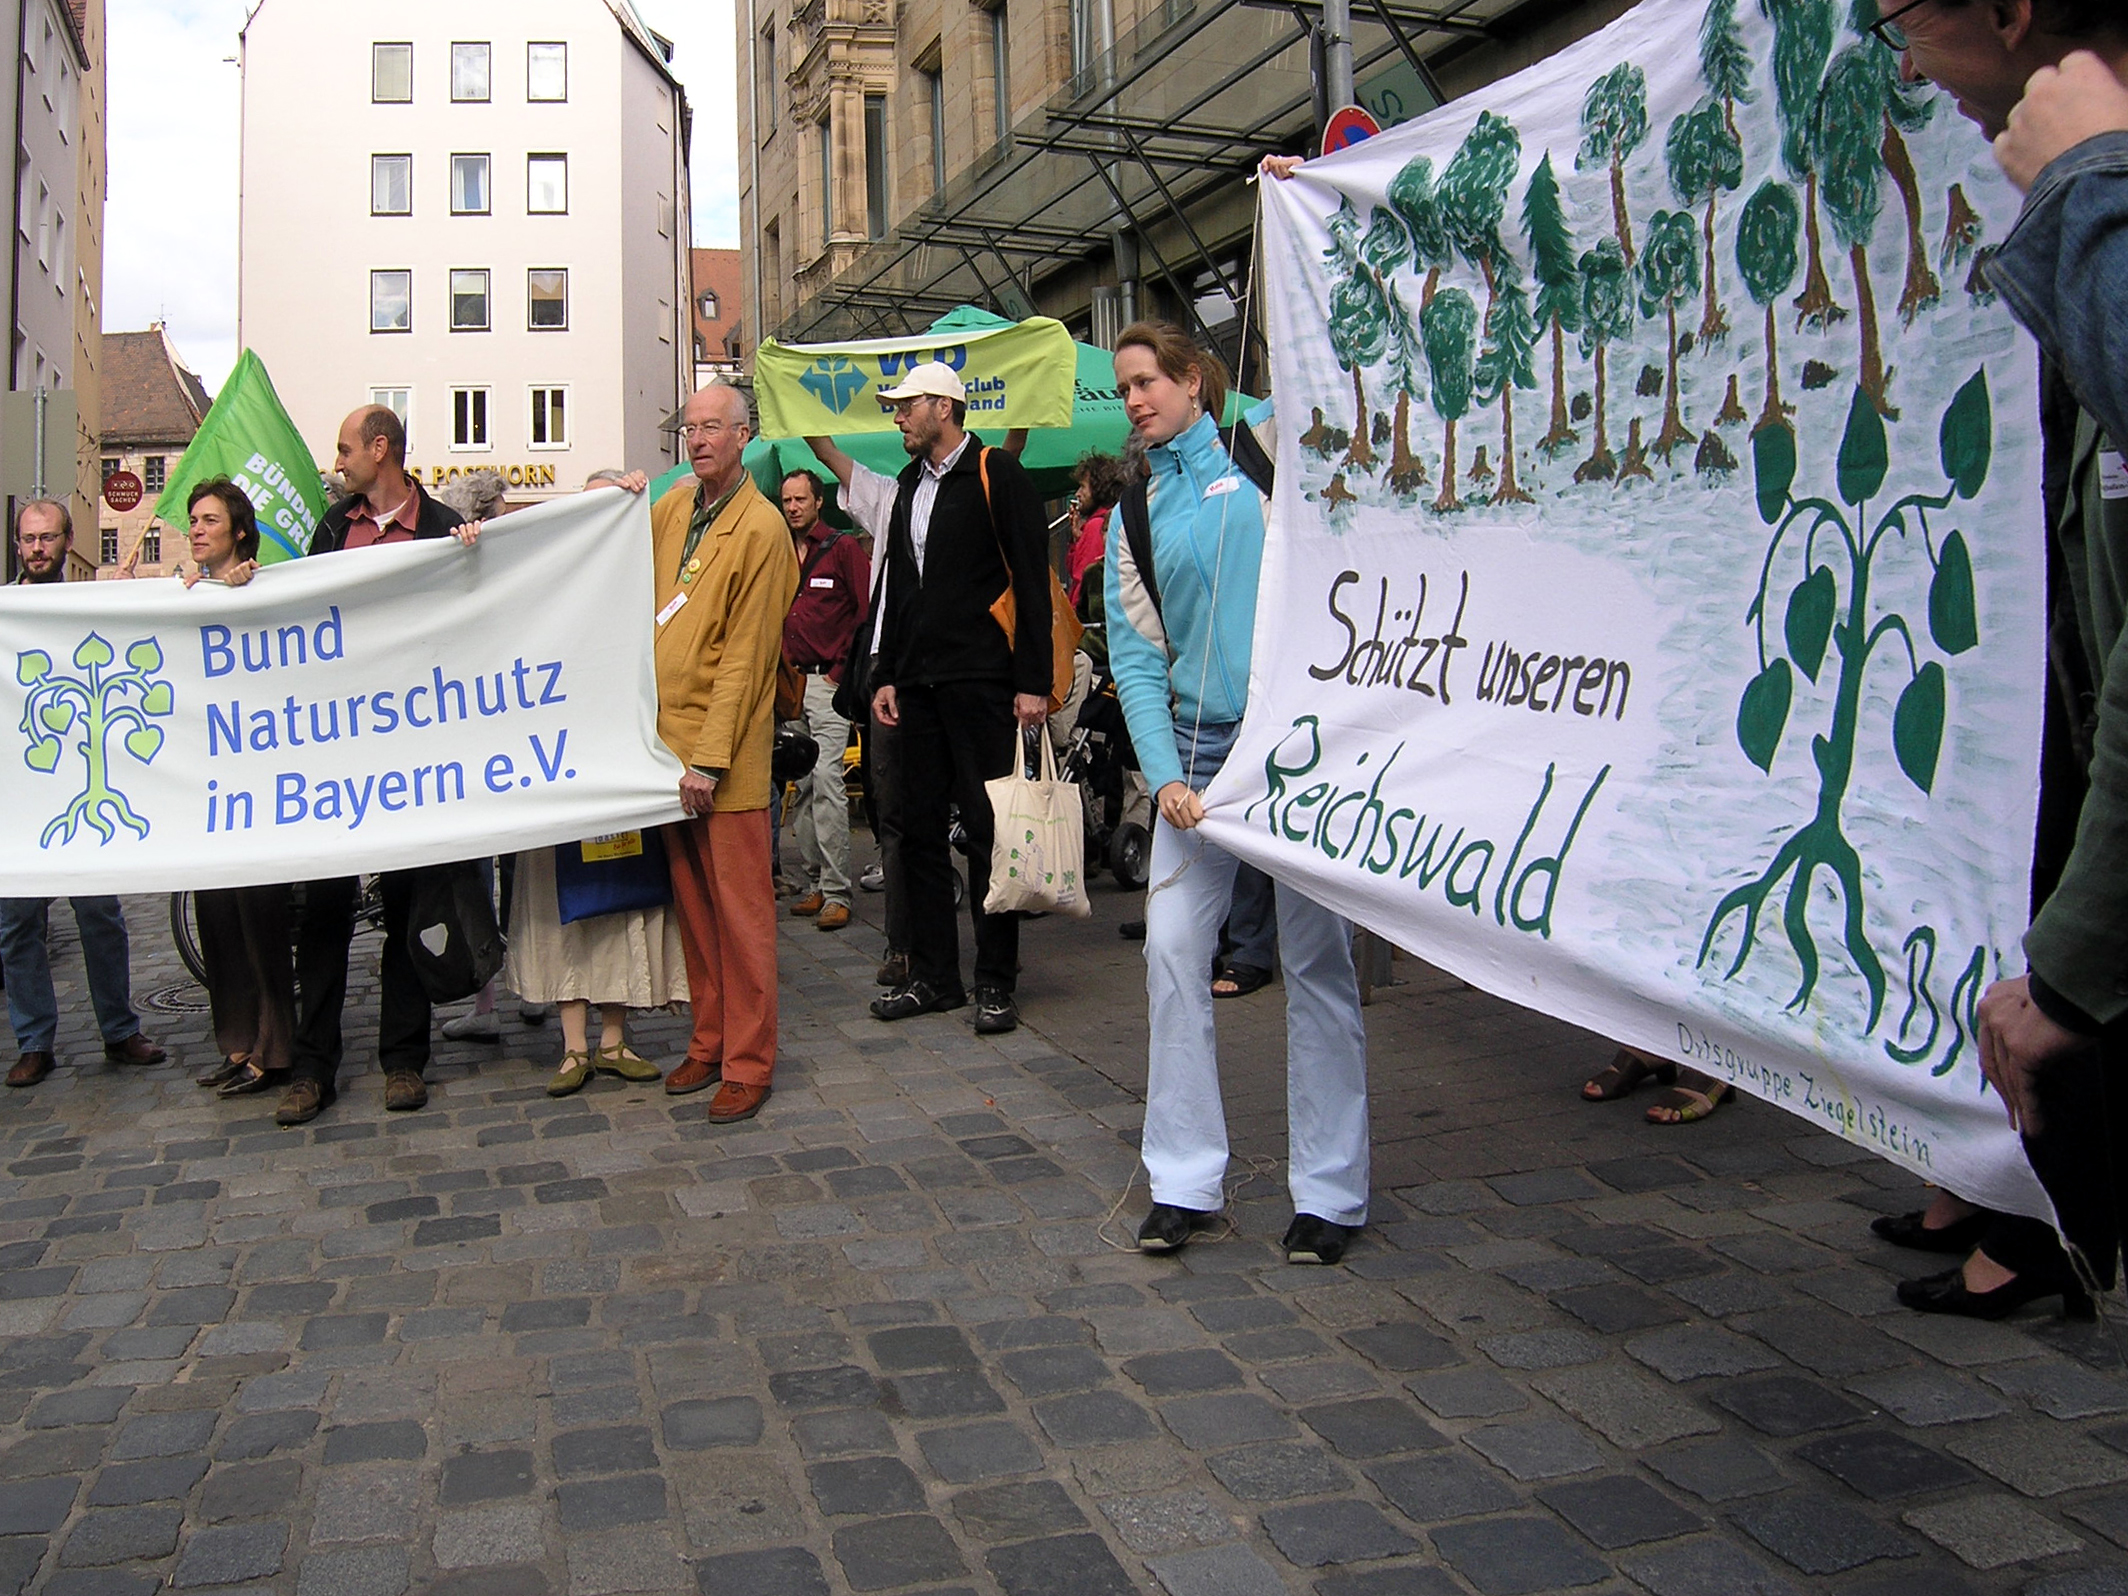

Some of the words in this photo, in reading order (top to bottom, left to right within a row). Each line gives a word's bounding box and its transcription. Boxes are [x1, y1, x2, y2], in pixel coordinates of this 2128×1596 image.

[231, 473, 274, 512] DIE
[245, 452, 317, 537] BÜNDN
[200, 605, 344, 678] Bund
[1308, 570, 1468, 704] Schützt
[1477, 640, 1631, 721] unseren
[206, 657, 567, 756] Naturschutz
[206, 779, 253, 833] in
[275, 761, 465, 830] Bayern
[484, 729, 577, 793] e.V.
[1245, 714, 1612, 940] Reichswald
[1677, 1022, 1791, 1100] Ortsgruppe
[1800, 1072, 1932, 1168] Ziegelstein
